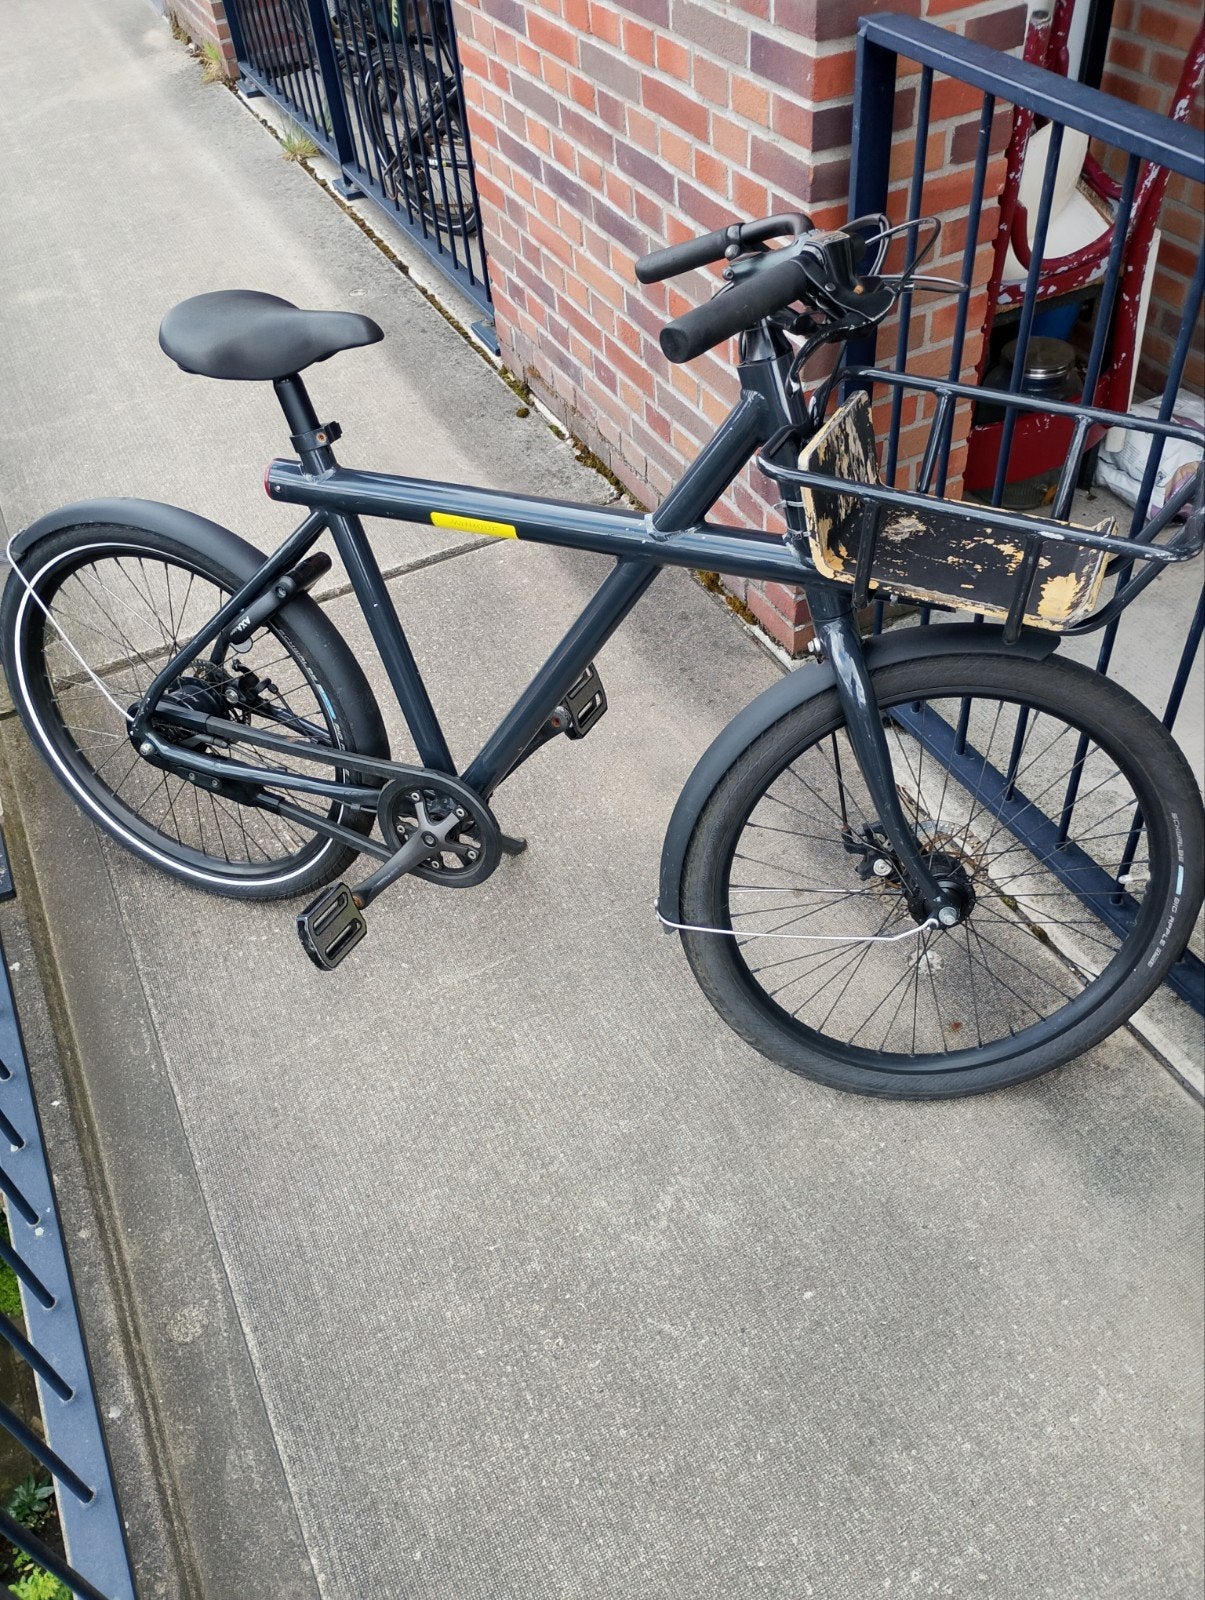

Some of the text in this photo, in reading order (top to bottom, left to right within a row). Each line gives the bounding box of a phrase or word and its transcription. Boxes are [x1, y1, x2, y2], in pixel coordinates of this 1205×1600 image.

[237, 616, 251, 632] AXA
[1159, 812, 1184, 946] SCHWALBE BIG APPLE
